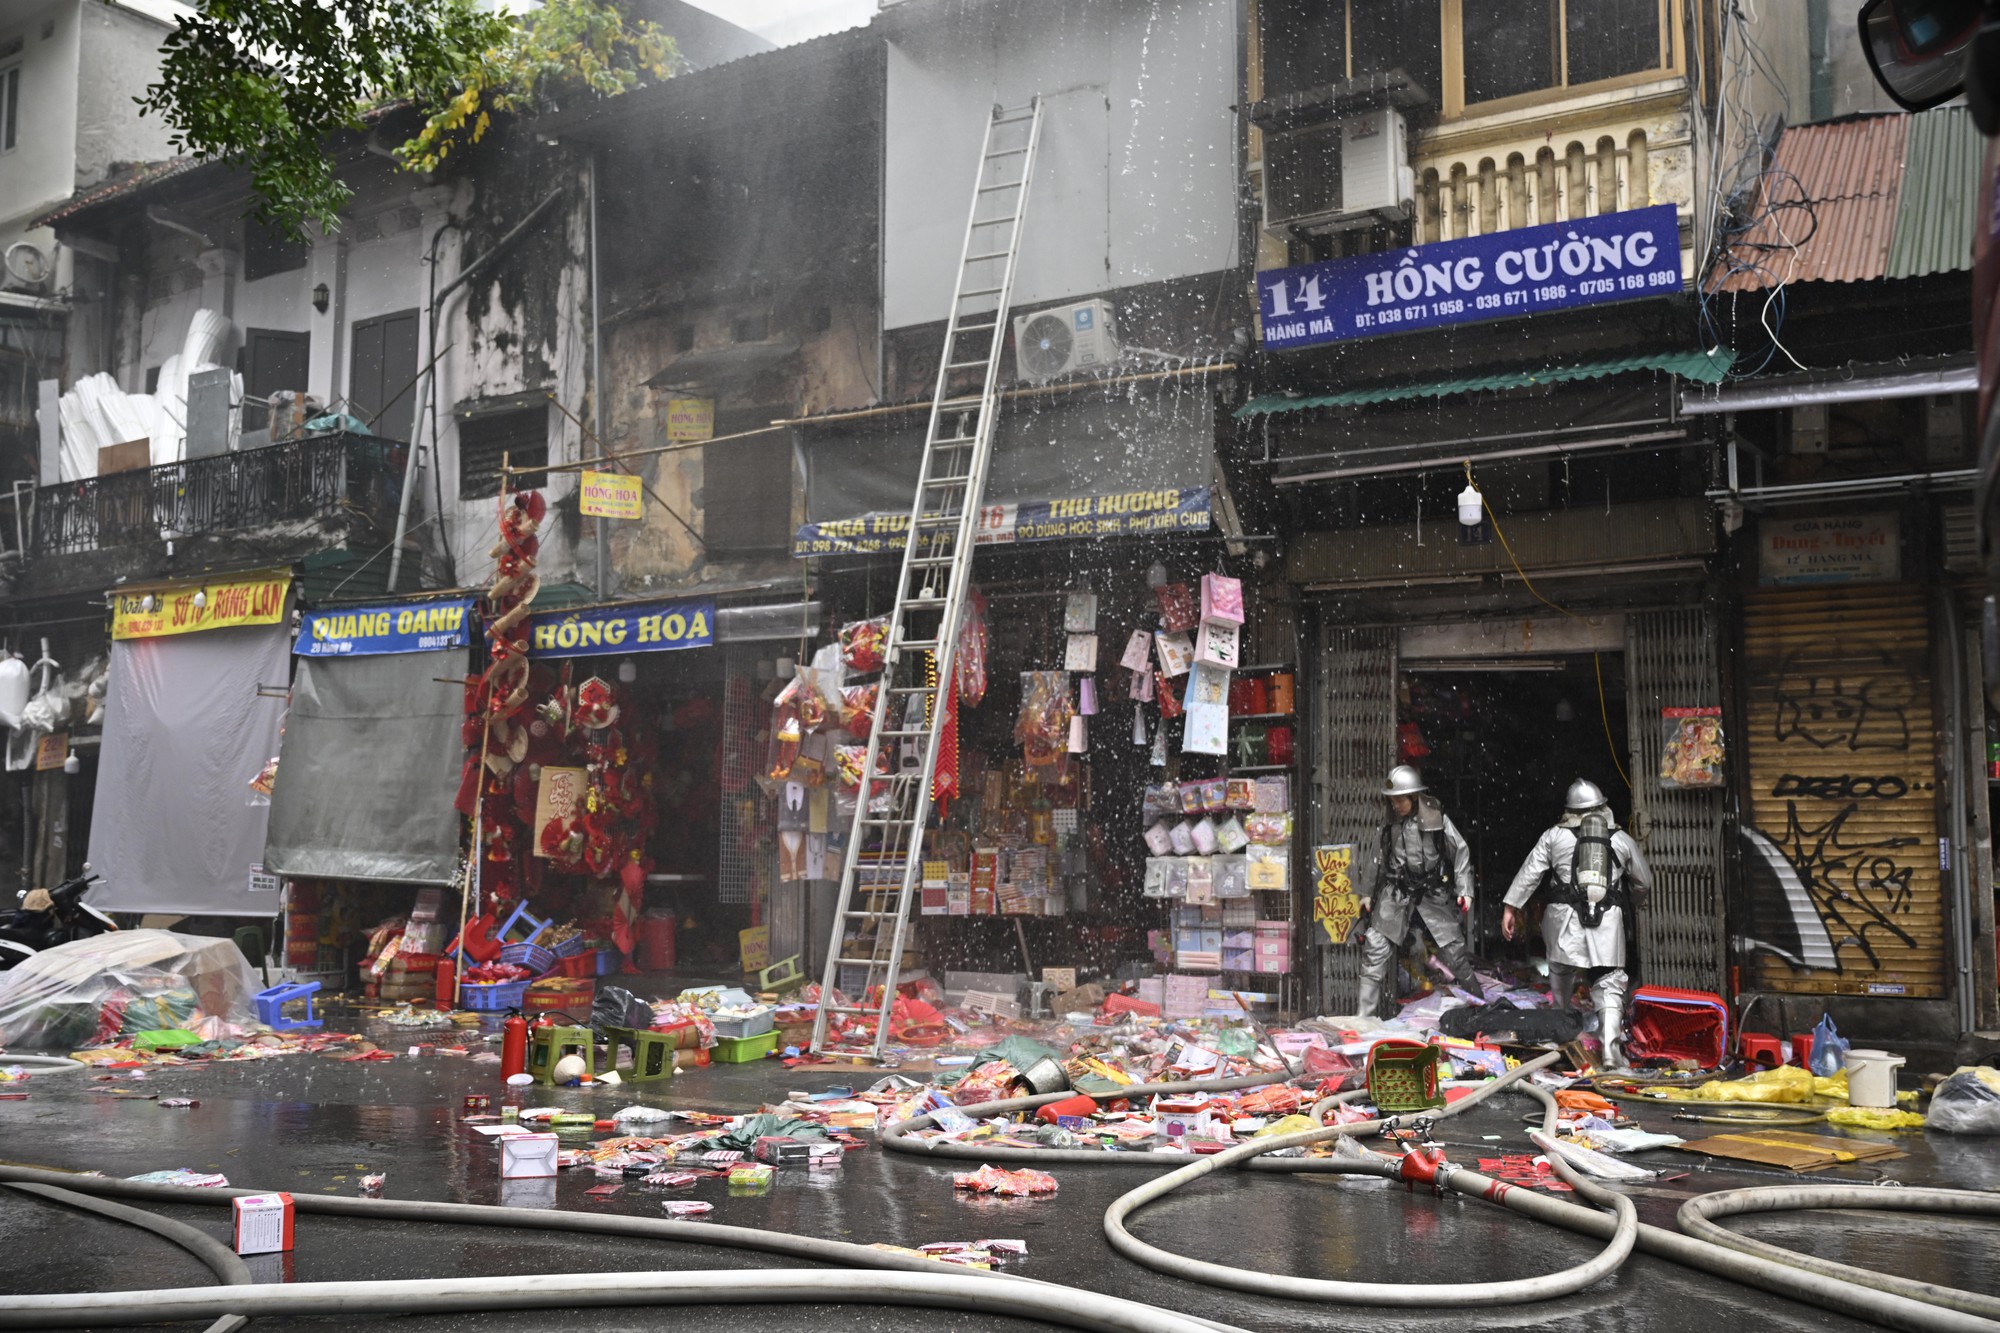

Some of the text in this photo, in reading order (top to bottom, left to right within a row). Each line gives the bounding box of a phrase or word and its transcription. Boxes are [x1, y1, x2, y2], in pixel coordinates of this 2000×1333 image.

[1364, 231, 1657, 306] HỒNG CƯỜNG
[1265, 274, 1327, 318] 14
[1356, 314, 1375, 328] ĐT:
[1378, 309, 1401, 324] 038
[1404, 305, 1427, 320] 671
[1432, 299, 1464, 316] 1958
[1476, 293, 1500, 309] 038
[1504, 290, 1528, 306] 671
[1533, 284, 1566, 302] 1986
[1580, 278, 1615, 296] 0705
[1618, 274, 1645, 291] 168
[1648, 269, 1676, 287] 980
[1266, 316, 1334, 341] HÀNG MÃ
[615, 489, 637, 501] HOA
[980, 505, 1004, 530] 16
[1049, 498, 1090, 519] THU
[818, 518, 866, 538] NGA
[1096, 518, 1121, 533] SINH
[1180, 511, 1209, 526] CUTE
[812, 540, 831, 552] 098
[312, 606, 464, 641] QUANG OANH
[534, 611, 710, 650] HỒNG HOA
